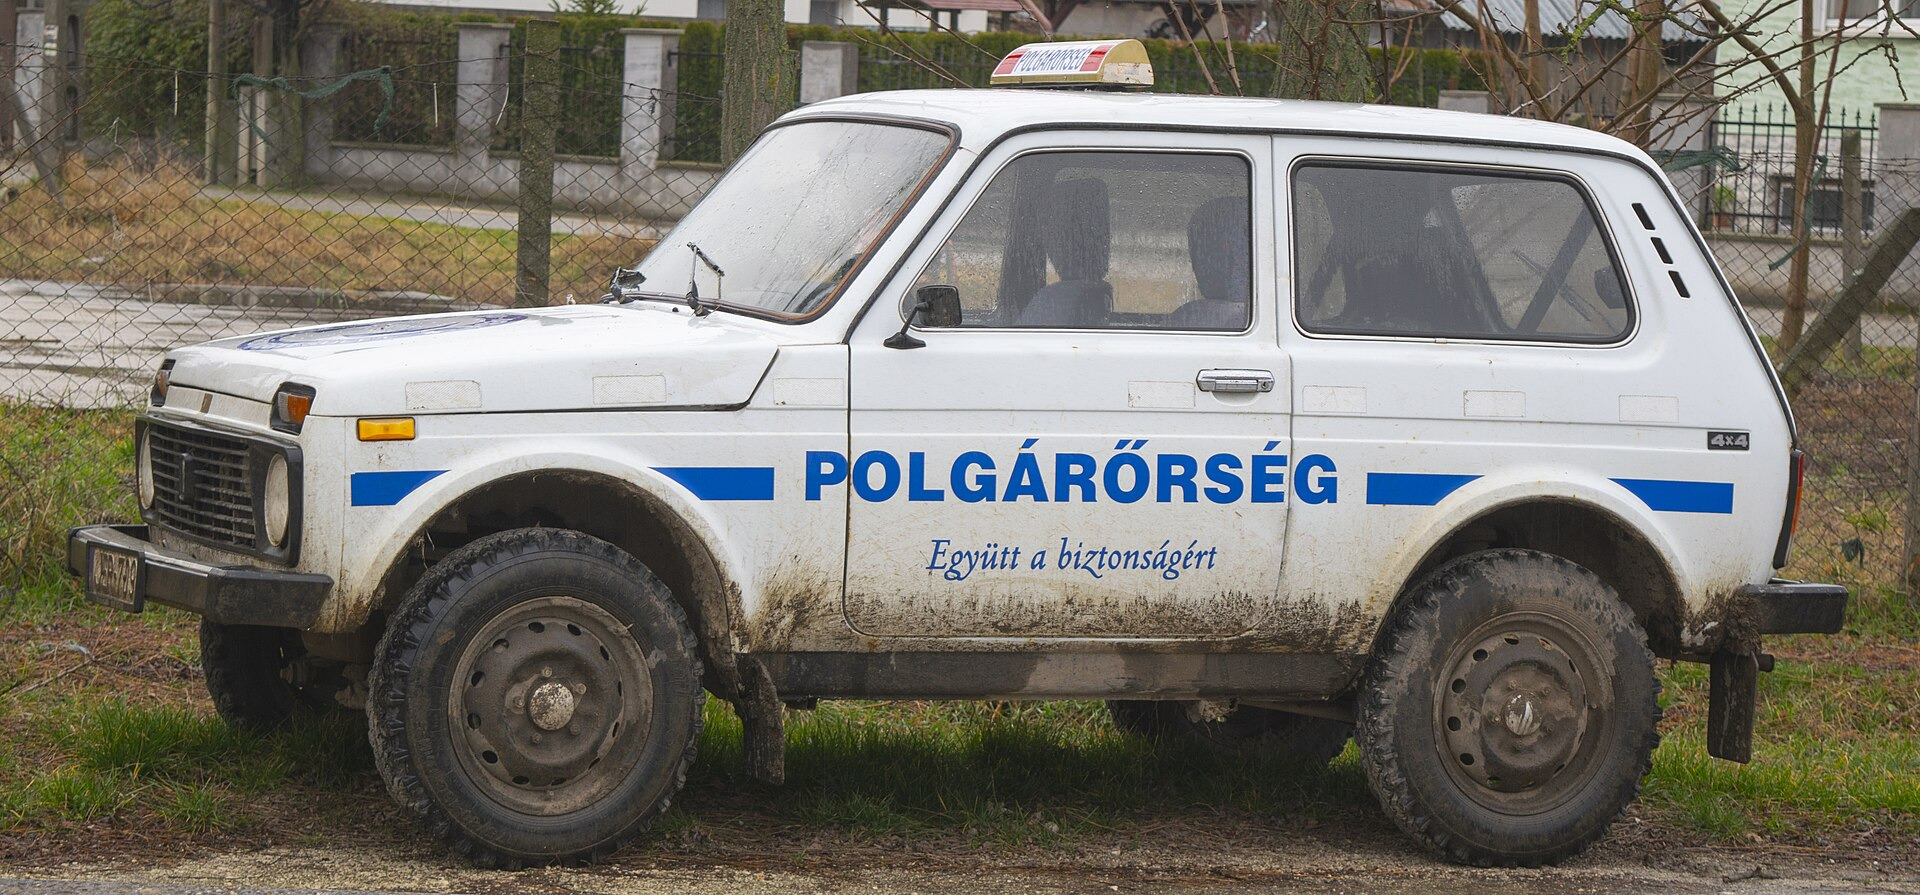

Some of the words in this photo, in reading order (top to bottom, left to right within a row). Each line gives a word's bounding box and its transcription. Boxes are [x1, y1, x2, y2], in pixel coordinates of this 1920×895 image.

[804, 438, 1338, 504] POLGÁRŐRSÉG
[925, 539, 1021, 581] Együtt
[1030, 550, 1046, 570] a
[1057, 536, 1217, 581] biztonságért
